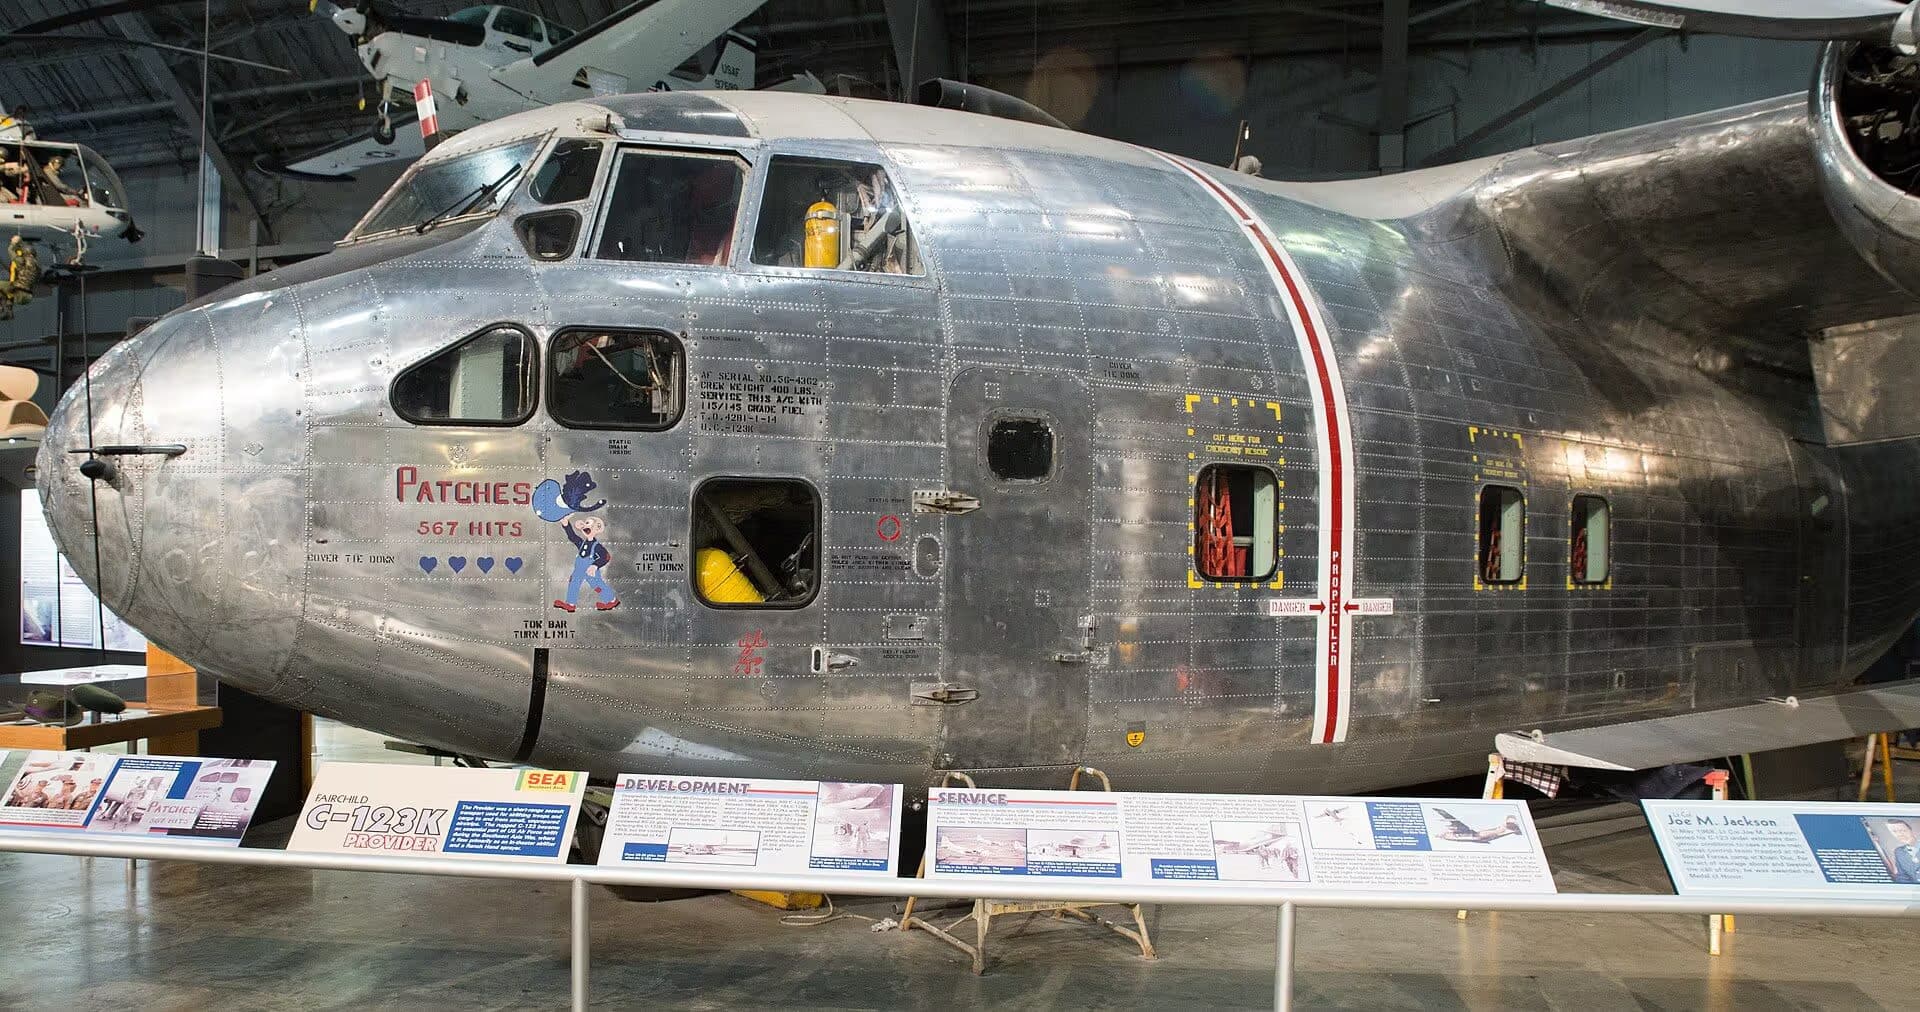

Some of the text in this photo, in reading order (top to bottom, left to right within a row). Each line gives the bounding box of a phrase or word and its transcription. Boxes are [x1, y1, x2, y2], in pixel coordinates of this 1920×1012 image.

[701, 371, 712, 379] AF
[719, 372, 753, 382] SERIAL
[700, 381, 816, 395] CREW WEIGHT 400 LBS.
[700, 391, 822, 405] SERVICE THIS A/C WITH
[701, 402, 804, 415] 115/145 GRADE FUEL
[396, 466, 531, 505] PATCHES
[417, 521, 522, 537] 567 HITS
[307, 554, 395, 563] COVER TIE DOWN
[642, 553, 673, 562] COVER
[635, 563, 685, 572] TIE DOWN
[1272, 601, 1306, 613] DANGER
[1330, 551, 1339, 666] PROPELLER
[1362, 601, 1392, 612] DANGER
[523, 620, 567, 629] TOW BAR
[513, 631, 576, 639] TURN LIMIT
[528, 773, 567, 785] SEA
[624, 778, 750, 795] DEVELOPMENT
[315, 793, 369, 804] FAIRCHILD
[937, 792, 1008, 806] SERVICE
[147, 801, 197, 814] PATCHES
[306, 804, 448, 836] C-123K
[1668, 815, 1777, 827] Joe M. Jackson
[343, 833, 439, 851] PROVIDER
